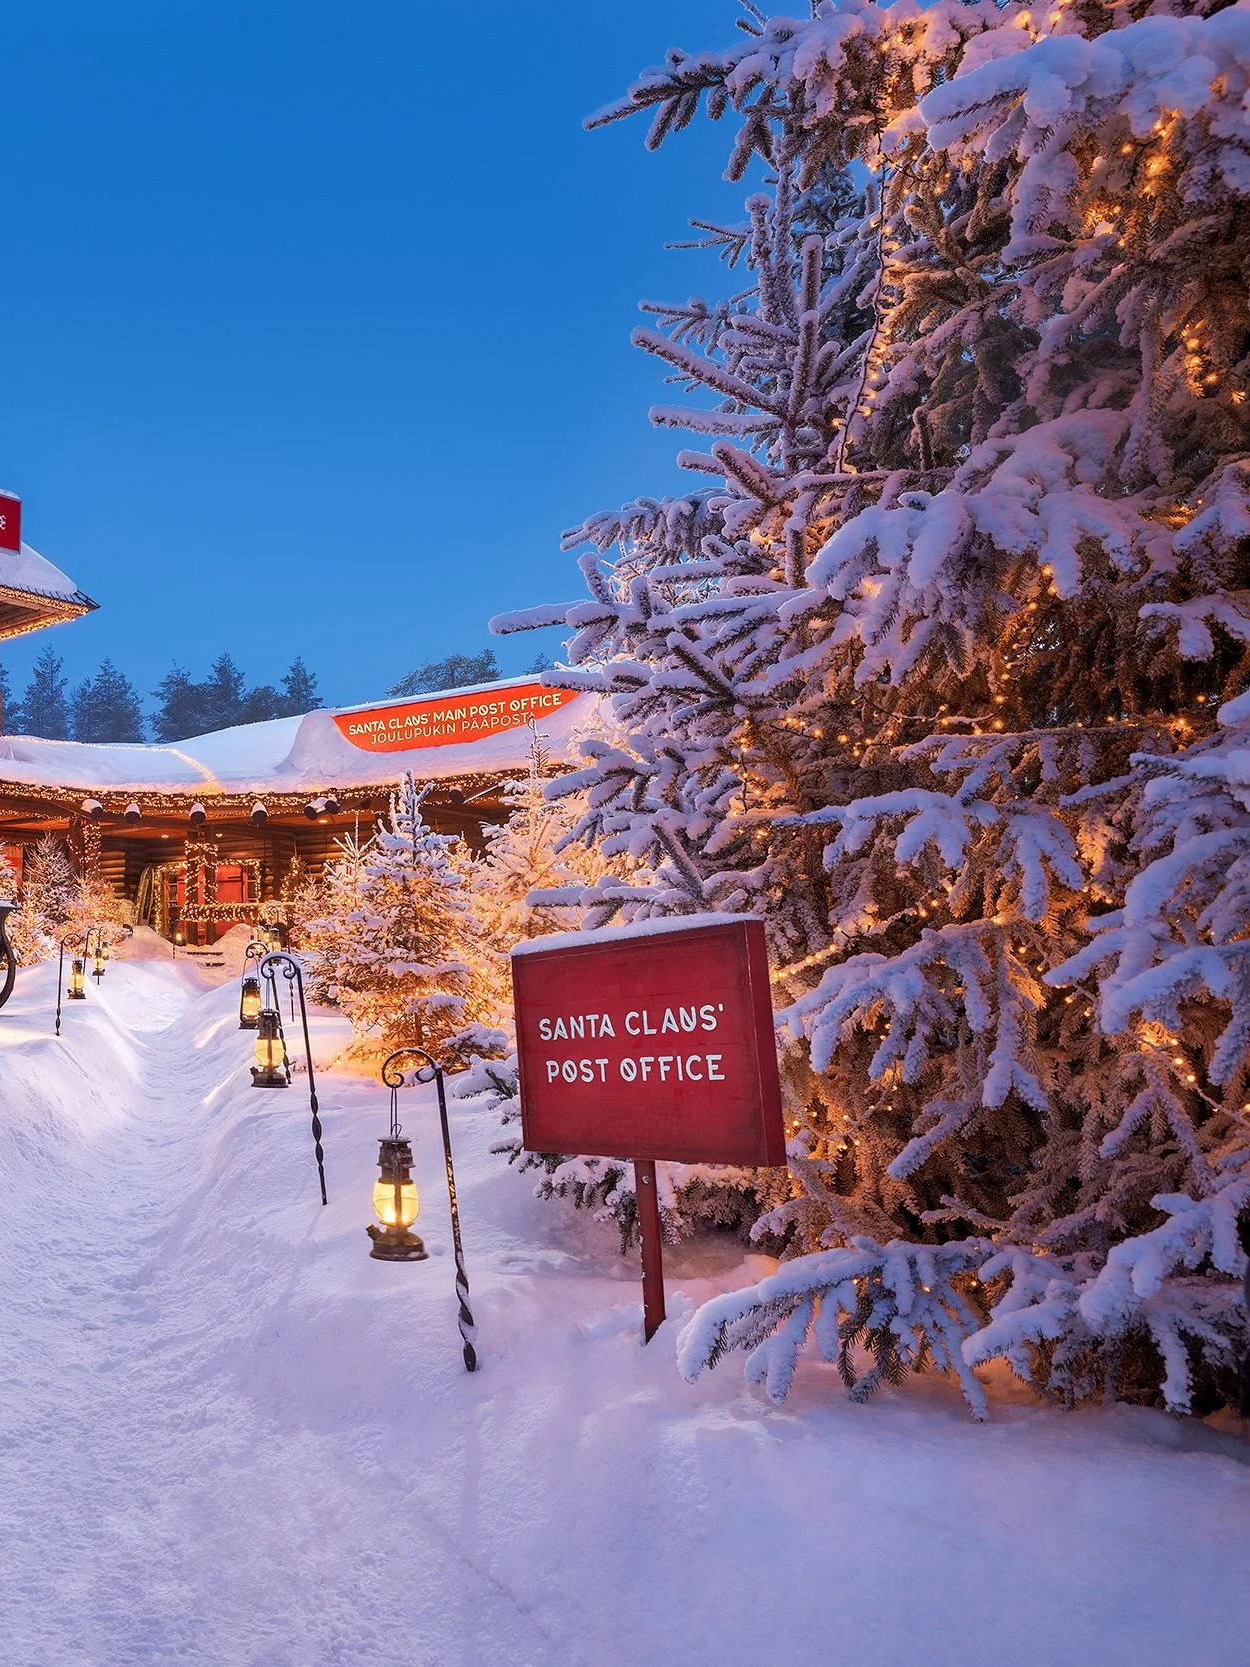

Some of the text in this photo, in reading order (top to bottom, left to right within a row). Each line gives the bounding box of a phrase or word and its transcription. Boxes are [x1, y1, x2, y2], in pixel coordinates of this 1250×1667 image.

[349, 721, 386, 735] SANTA
[433, 708, 466, 723] MAIN
[469, 701, 506, 716] POST
[509, 693, 562, 711] OFFICE
[370, 723, 456, 745] JOULUPUKIN
[538, 1003, 725, 1041] SANTA CLAUS'
[545, 1054, 726, 1083] POST OFFICE
